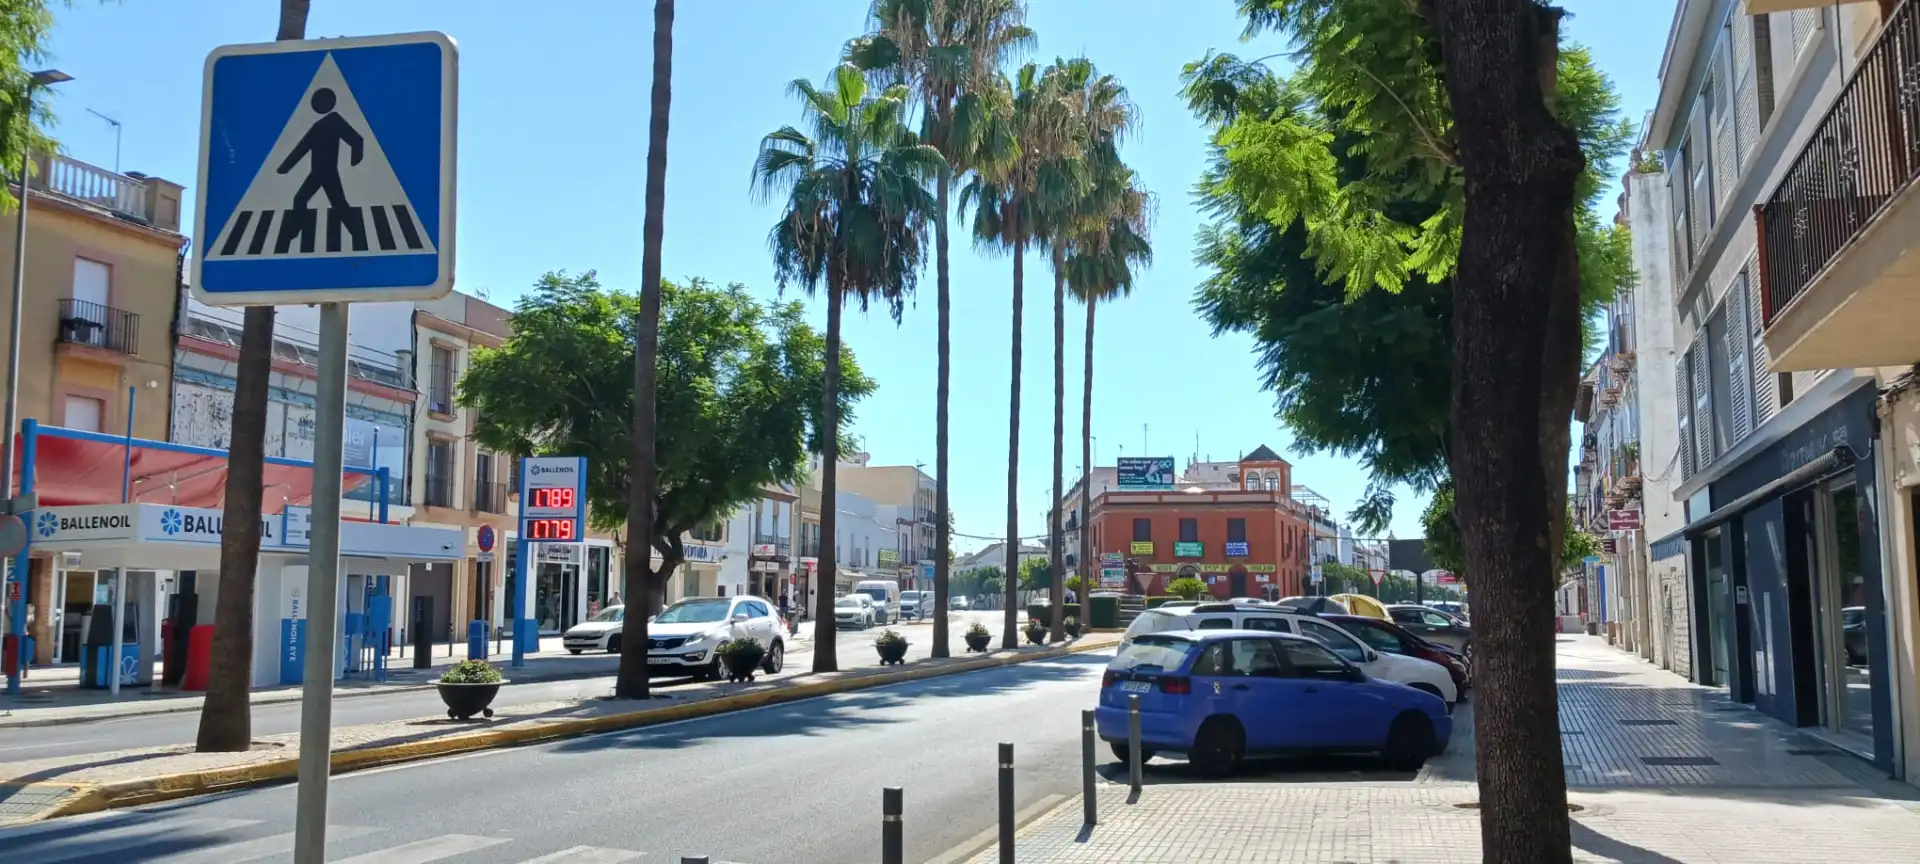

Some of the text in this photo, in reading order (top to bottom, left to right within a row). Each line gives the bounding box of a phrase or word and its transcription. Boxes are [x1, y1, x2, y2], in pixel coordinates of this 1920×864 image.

[541, 465, 574, 474] BALLENOIL
[60, 515, 131, 531] BALLENOIL
[183, 514, 273, 539] BALLIL
[289, 599, 299, 661] BALLENOIL EYE
